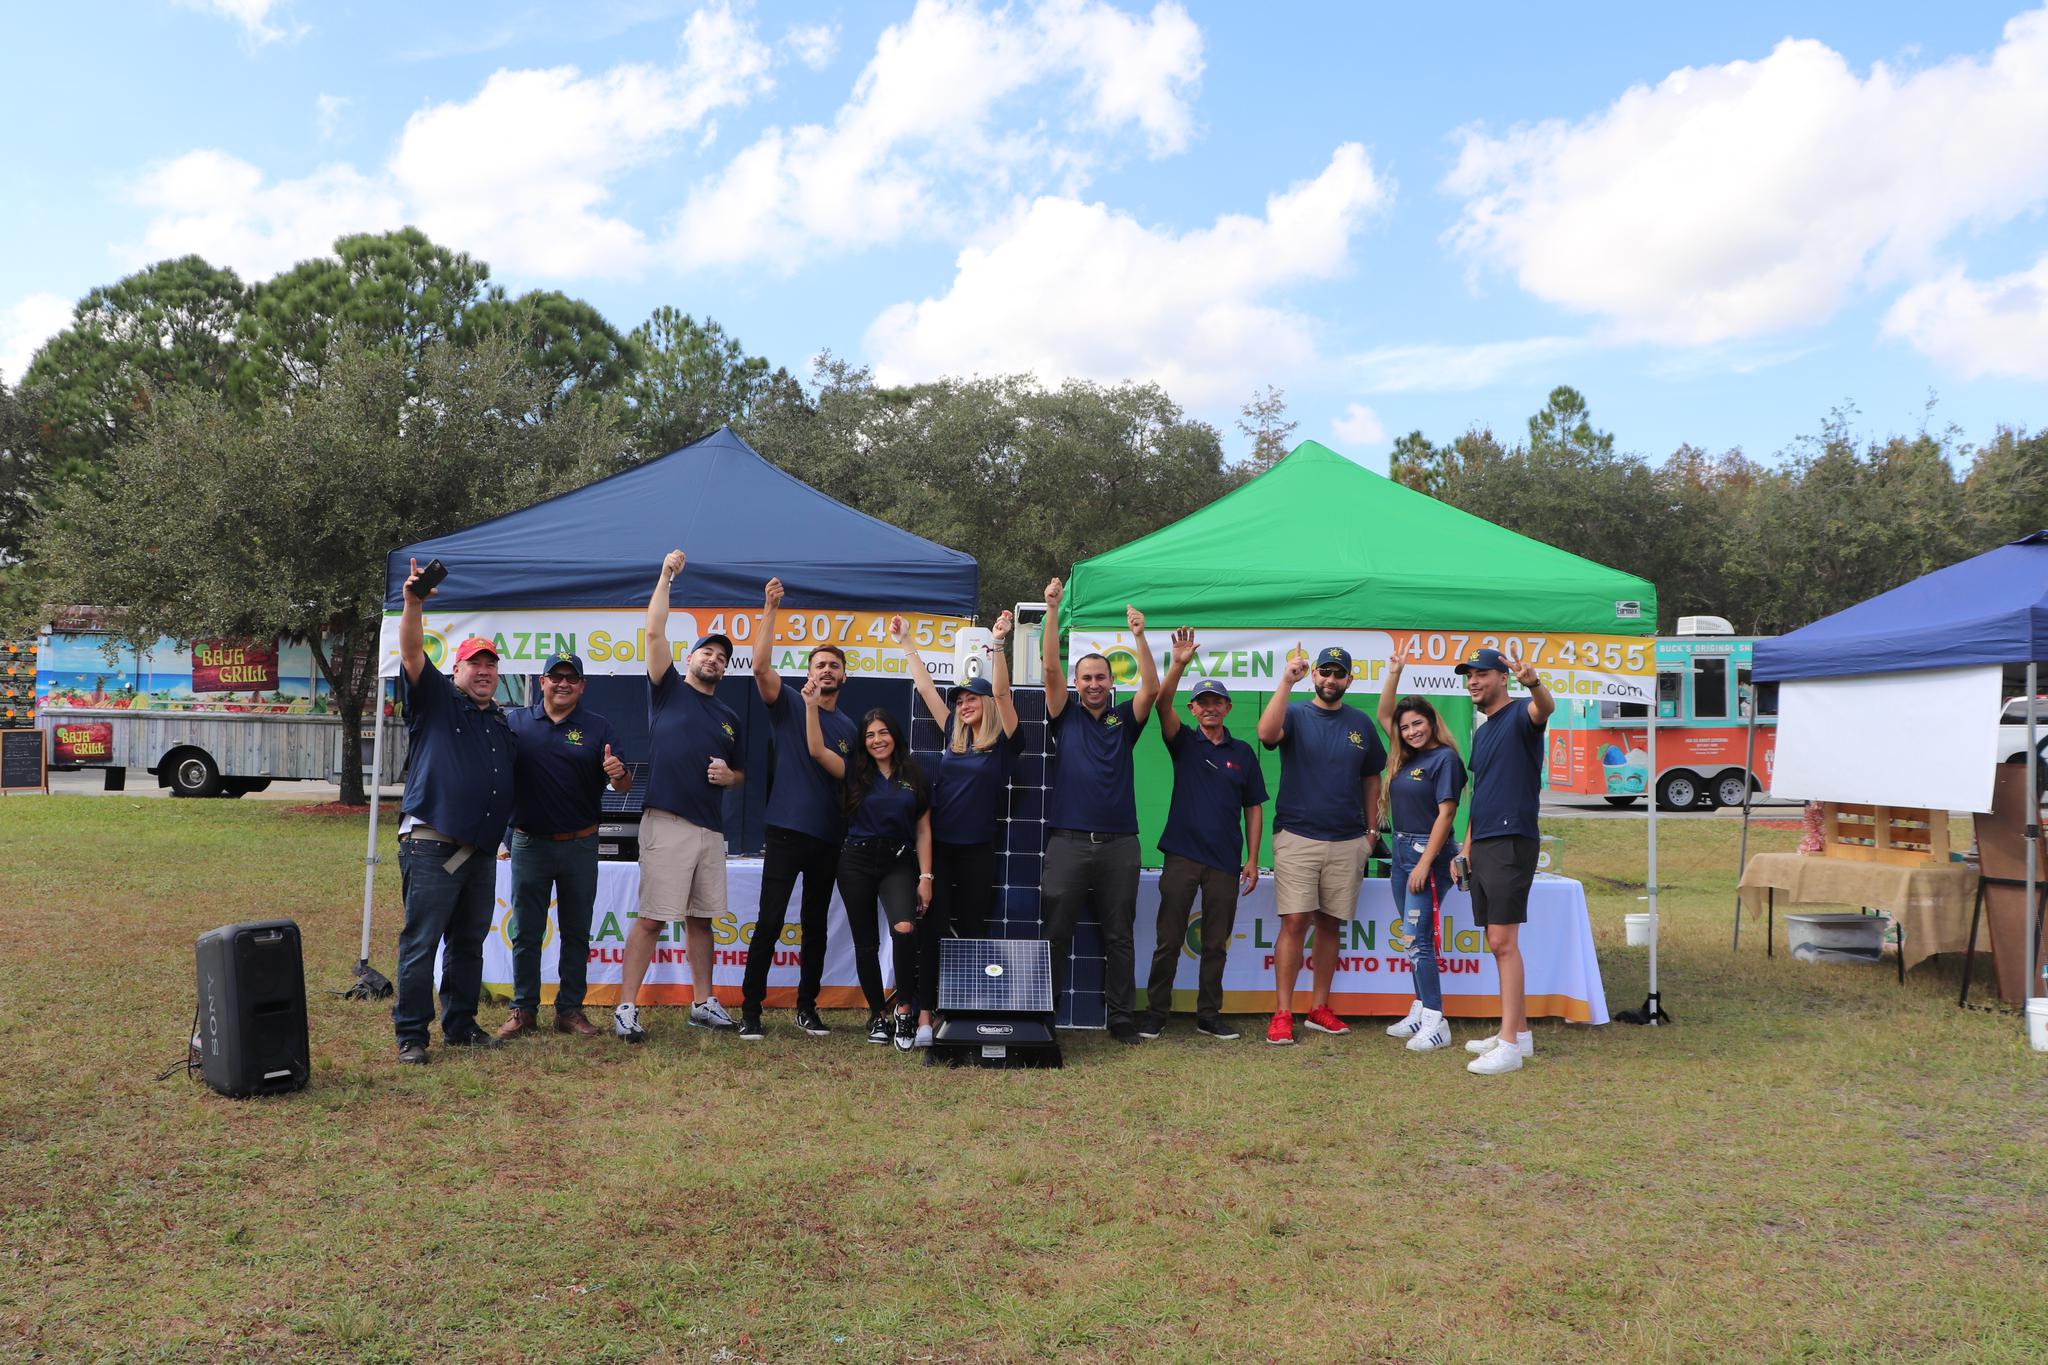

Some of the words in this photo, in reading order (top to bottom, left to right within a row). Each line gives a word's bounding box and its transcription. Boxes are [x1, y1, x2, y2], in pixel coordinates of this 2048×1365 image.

[707, 613, 957, 648] 40.307.455
[469, 632, 576, 660] AZEN
[587, 627, 688, 662] Solr
[1404, 634, 1645, 671] 407307.4355
[1695, 644, 1735, 653] ORIGINAL
[202, 648, 245, 667] BAJA
[1286, 648, 1386, 680] Sar
[219, 664, 268, 683] GRILL
[62, 731, 90, 744] BAJA
[73, 742, 105, 755] GRILL
[1254, 918, 1376, 950] LEN
[587, 948, 625, 964] PLU
[650, 948, 690, 964] INT
[773, 951, 802, 966] UN
[1335, 956, 1380, 973] NTO
[1386, 957, 1413, 973] TH
[207, 973, 219, 1056] SONY
